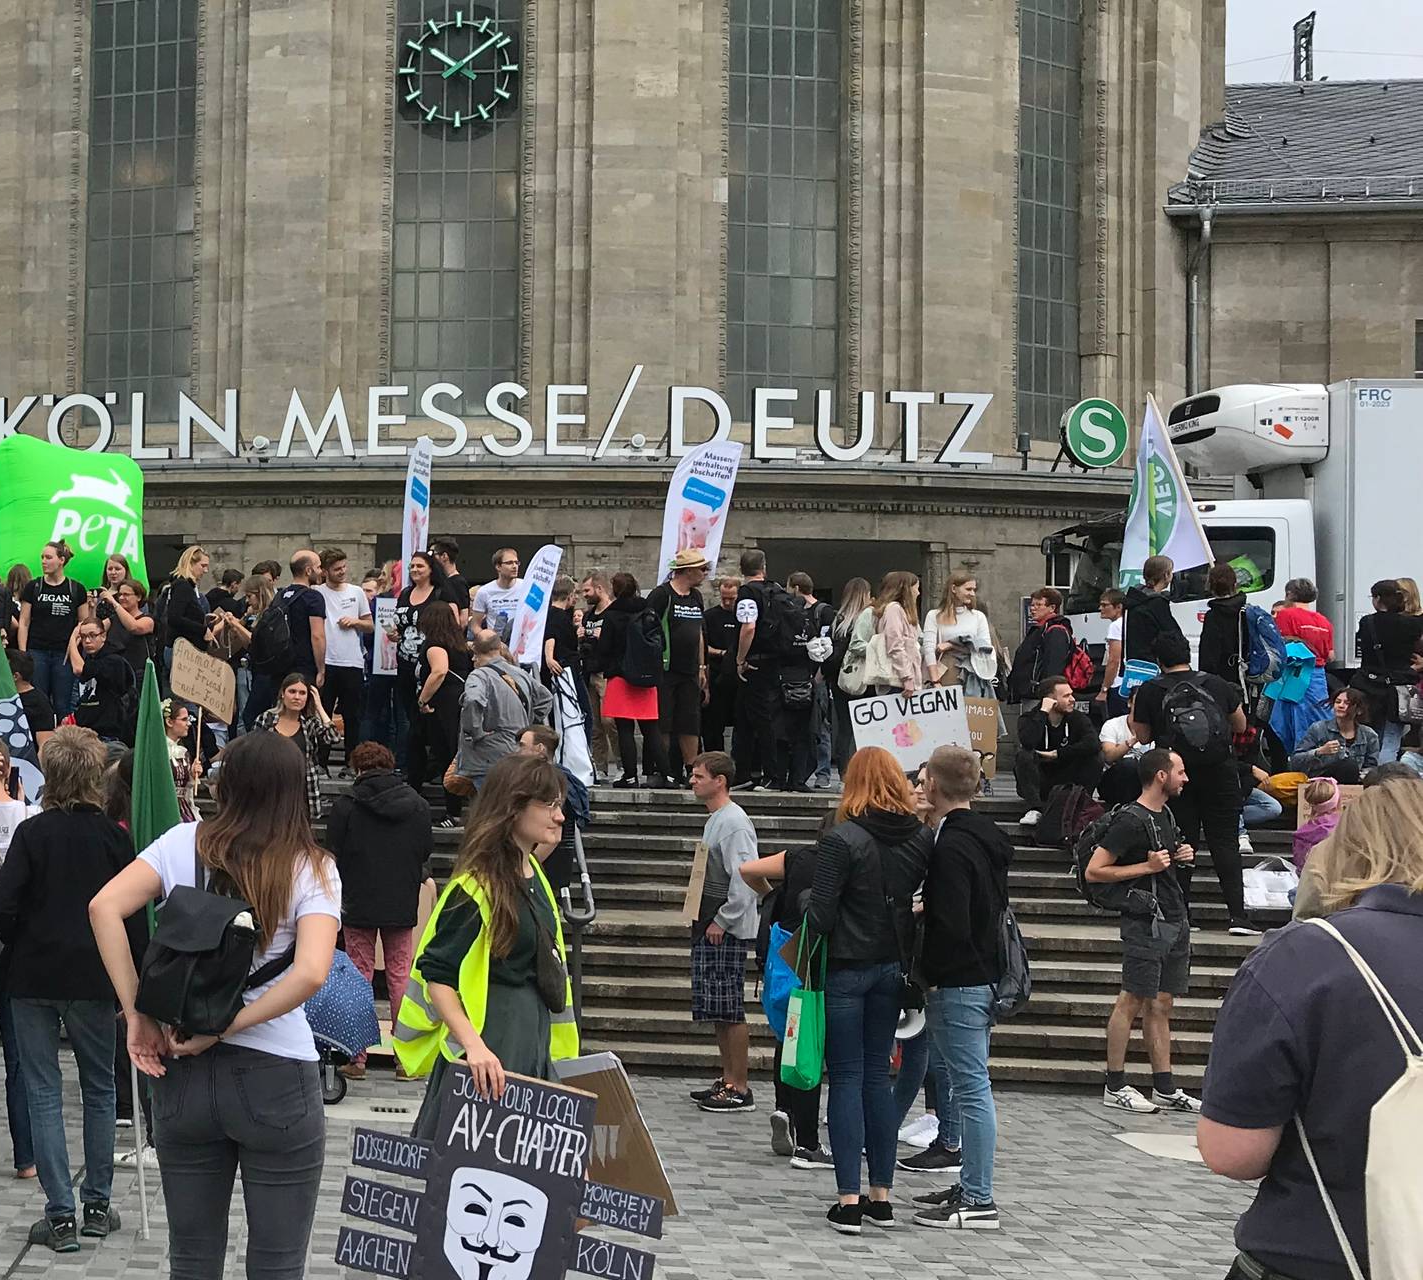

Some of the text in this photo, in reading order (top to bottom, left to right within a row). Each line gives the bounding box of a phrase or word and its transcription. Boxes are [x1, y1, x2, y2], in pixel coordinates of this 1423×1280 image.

[1359, 388, 1392, 401] FRC
[1080, 407, 1116, 460] S
[853, 688, 958, 725] GO VEGAN
[453, 1072, 491, 1105] JO
[536, 1091, 584, 1128] LOCAL
[355, 1134, 429, 1169] DÜSSELDORF
[447, 1102, 587, 1178] AV-CHAPTER
[348, 1180, 419, 1226] SIEGEN
[580, 1202, 649, 1231] GLADBACH
[339, 1231, 411, 1275] AACHEN
[577, 1238, 644, 1280] KÖLN
